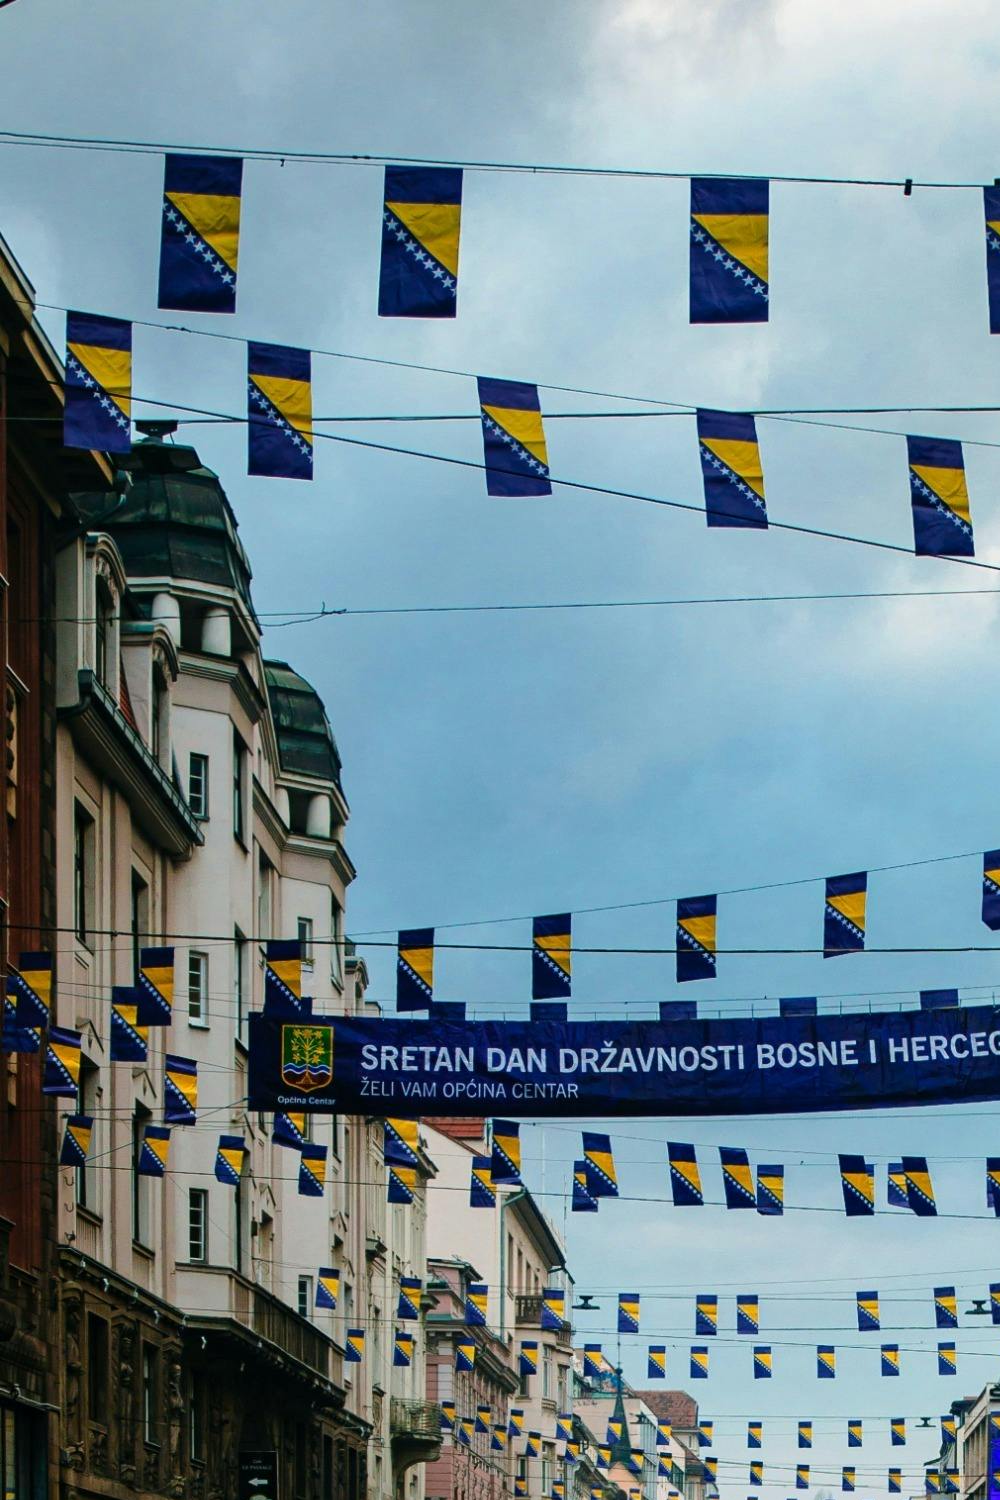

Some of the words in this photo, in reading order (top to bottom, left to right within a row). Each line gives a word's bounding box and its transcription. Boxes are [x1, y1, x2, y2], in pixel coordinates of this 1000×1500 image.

[361, 1044, 475, 1073] SRETAN
[487, 1047, 547, 1073] DAN
[559, 1040, 744, 1073] DRŽAVNOSTI
[756, 1040, 859, 1069] BOSNE
[869, 1039, 877, 1064] I
[360, 1076, 395, 1097] ŽELI
[401, 1081, 437, 1098] VAM
[443, 1078, 507, 1099] OPĆINA
[512, 1083, 579, 1099] CENTAR
[308, 1096, 337, 1106] Centar
